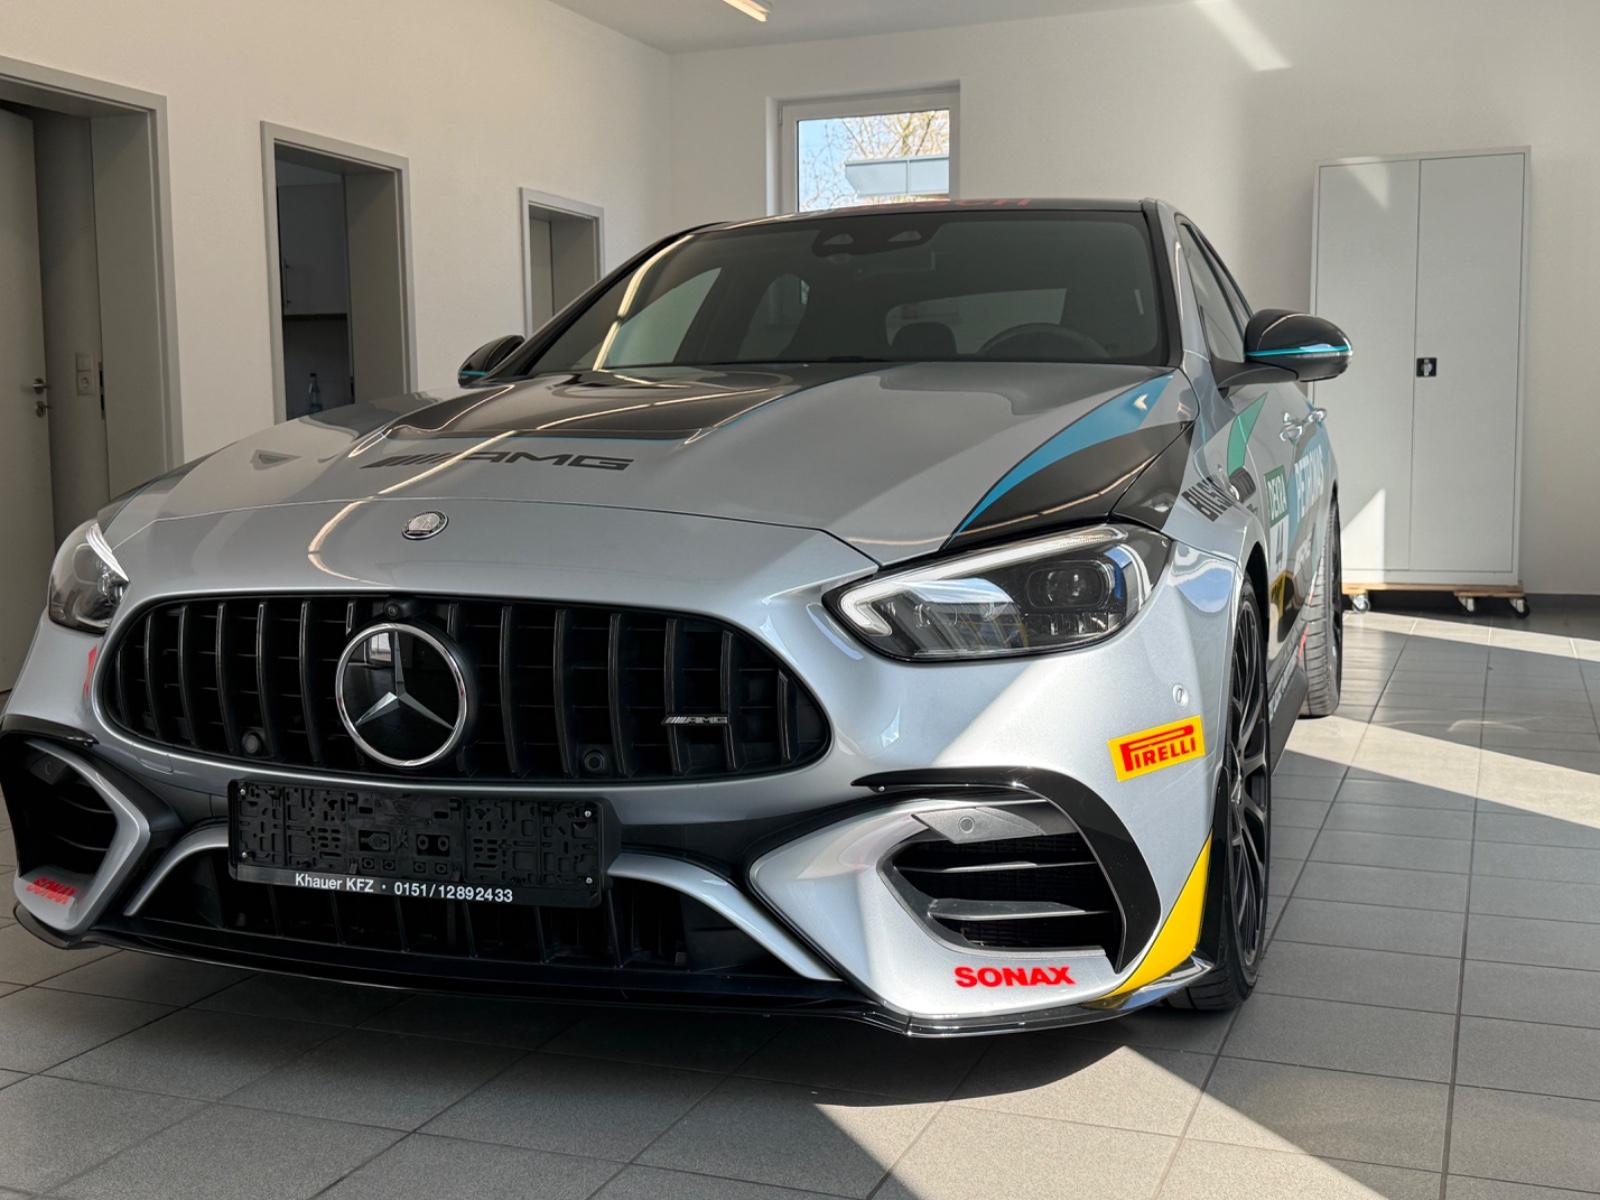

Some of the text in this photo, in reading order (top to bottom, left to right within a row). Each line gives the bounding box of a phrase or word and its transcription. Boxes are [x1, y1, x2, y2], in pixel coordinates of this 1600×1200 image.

[1119, 724, 1196, 772] PIRELLI
[295, 873, 343, 890] Khauer
[346, 877, 374, 893] KFZ
[954, 965, 1076, 988] SONAX
